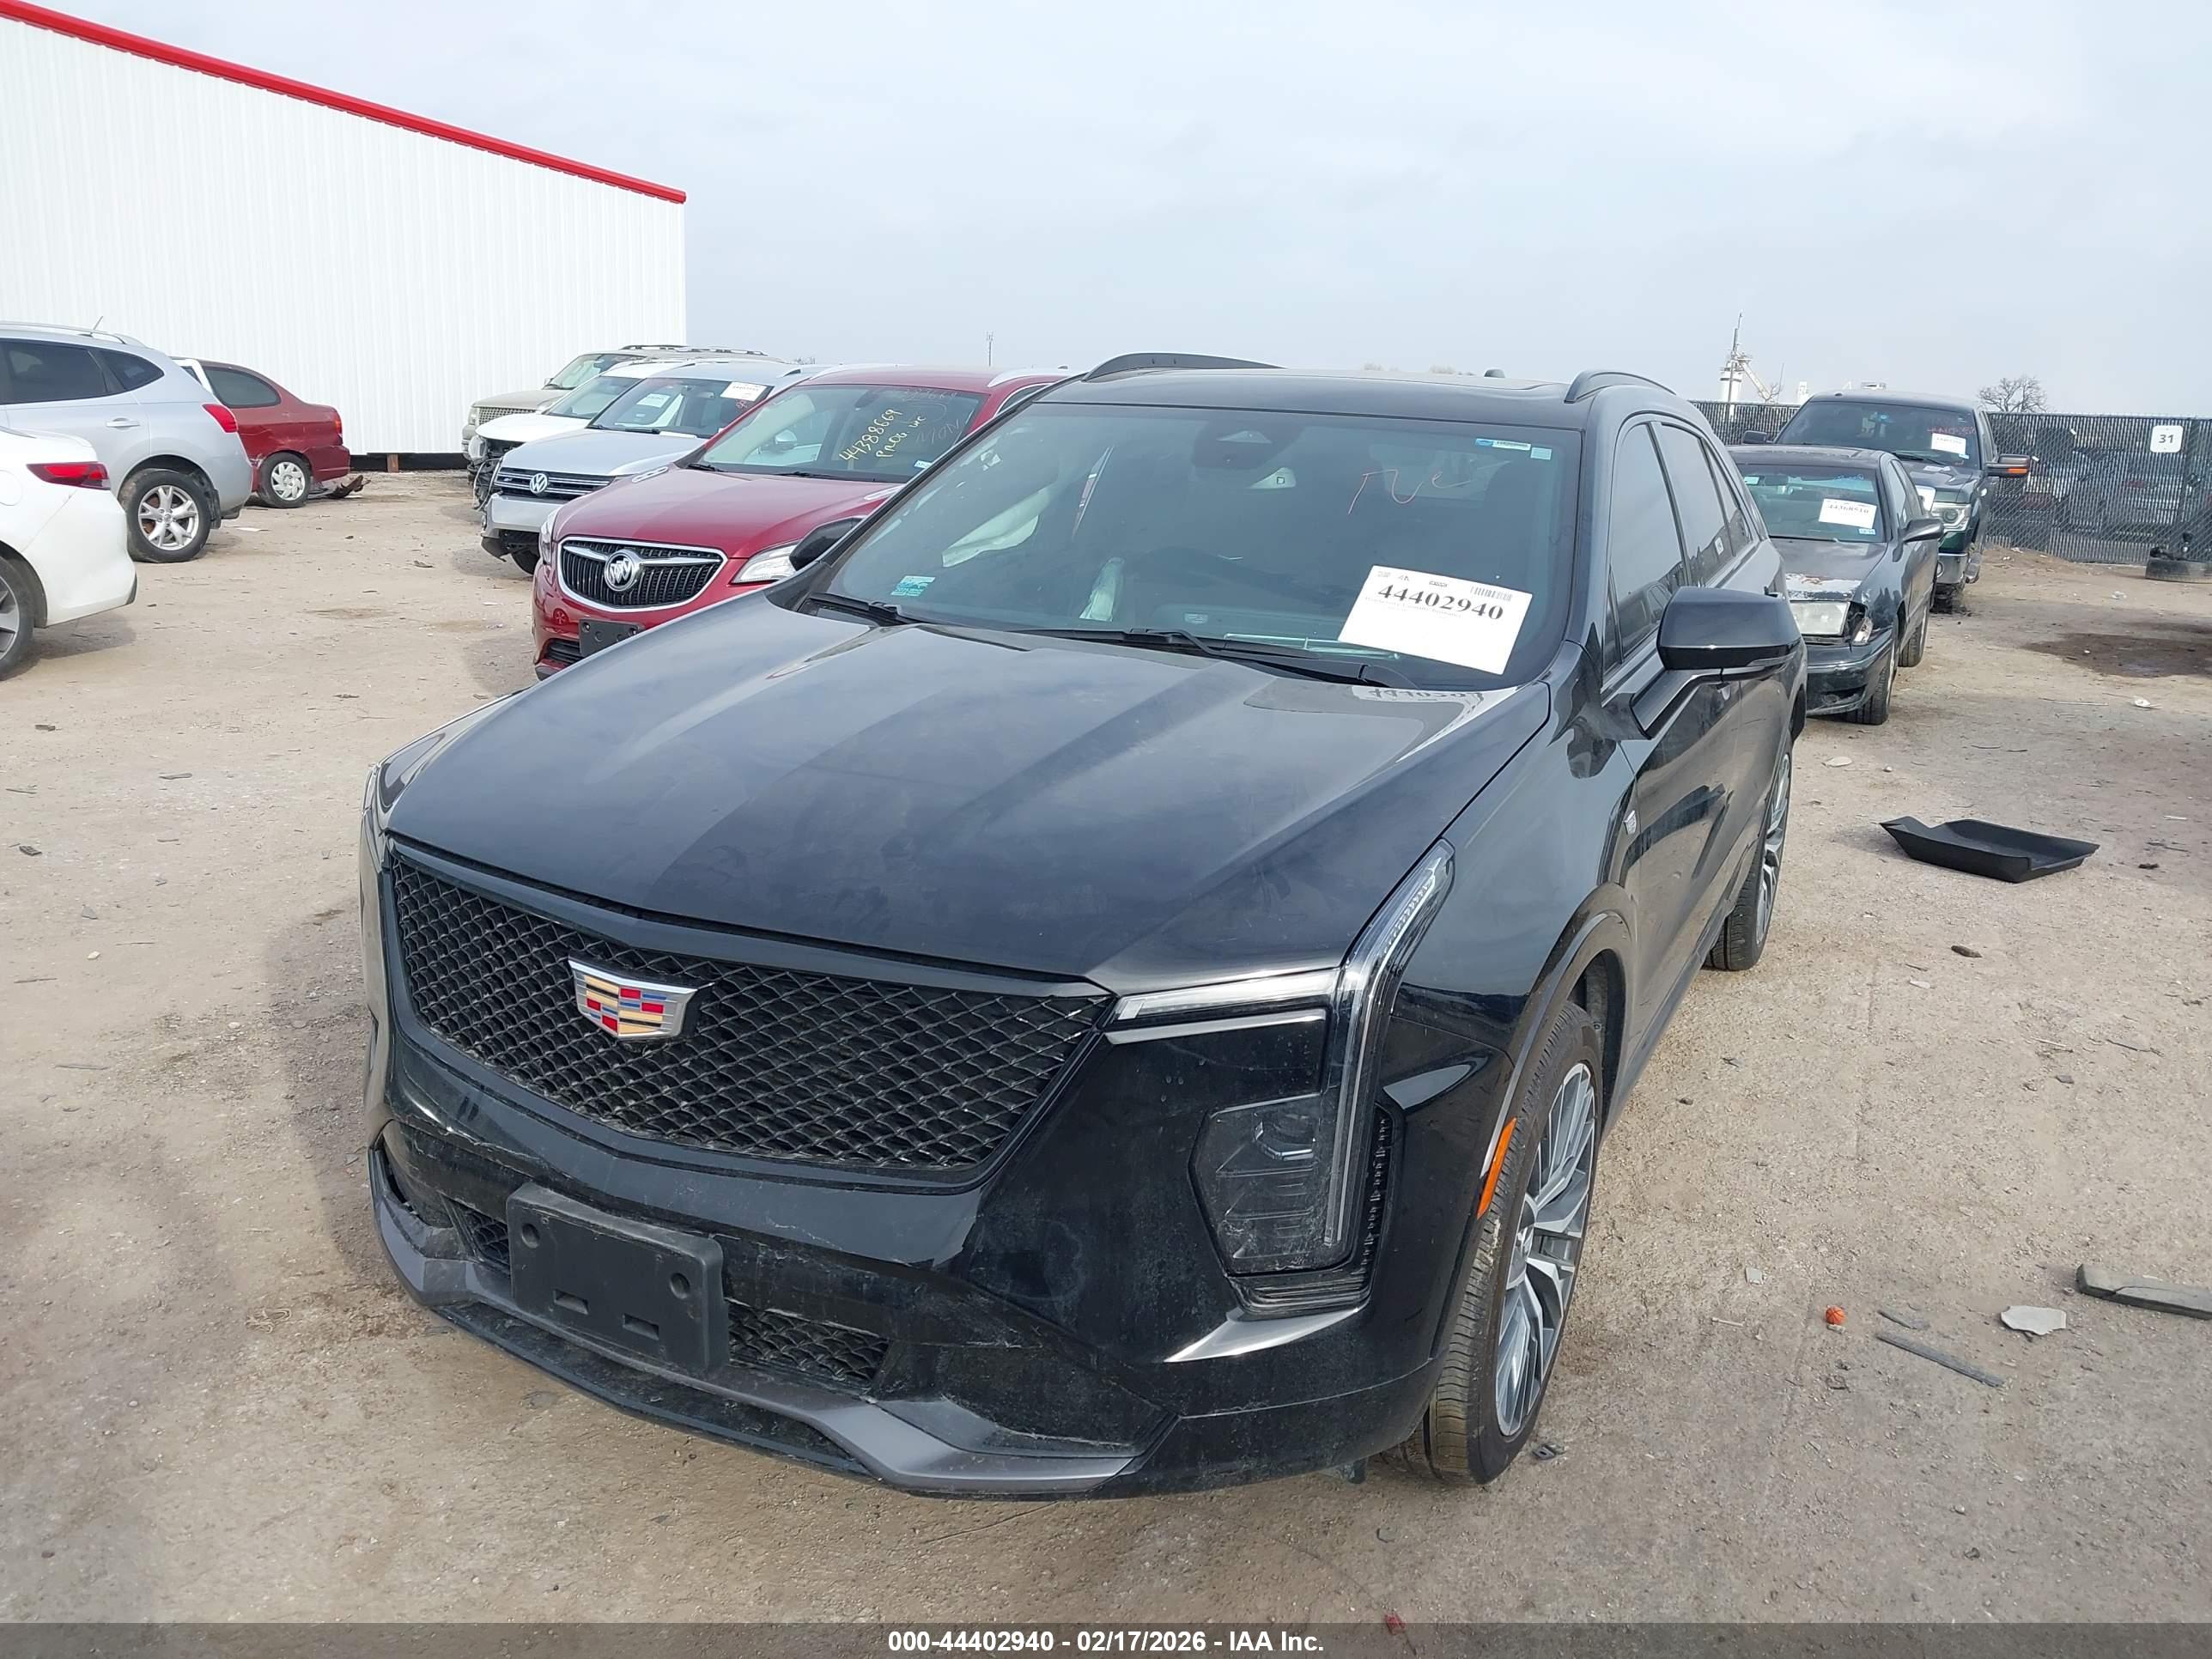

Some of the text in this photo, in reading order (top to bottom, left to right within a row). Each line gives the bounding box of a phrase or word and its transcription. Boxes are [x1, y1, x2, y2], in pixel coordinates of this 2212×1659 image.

[839, 409, 903, 460] 44388669
[2159, 434, 2174, 444] 31
[1377, 584, 1504, 619] 44402940
